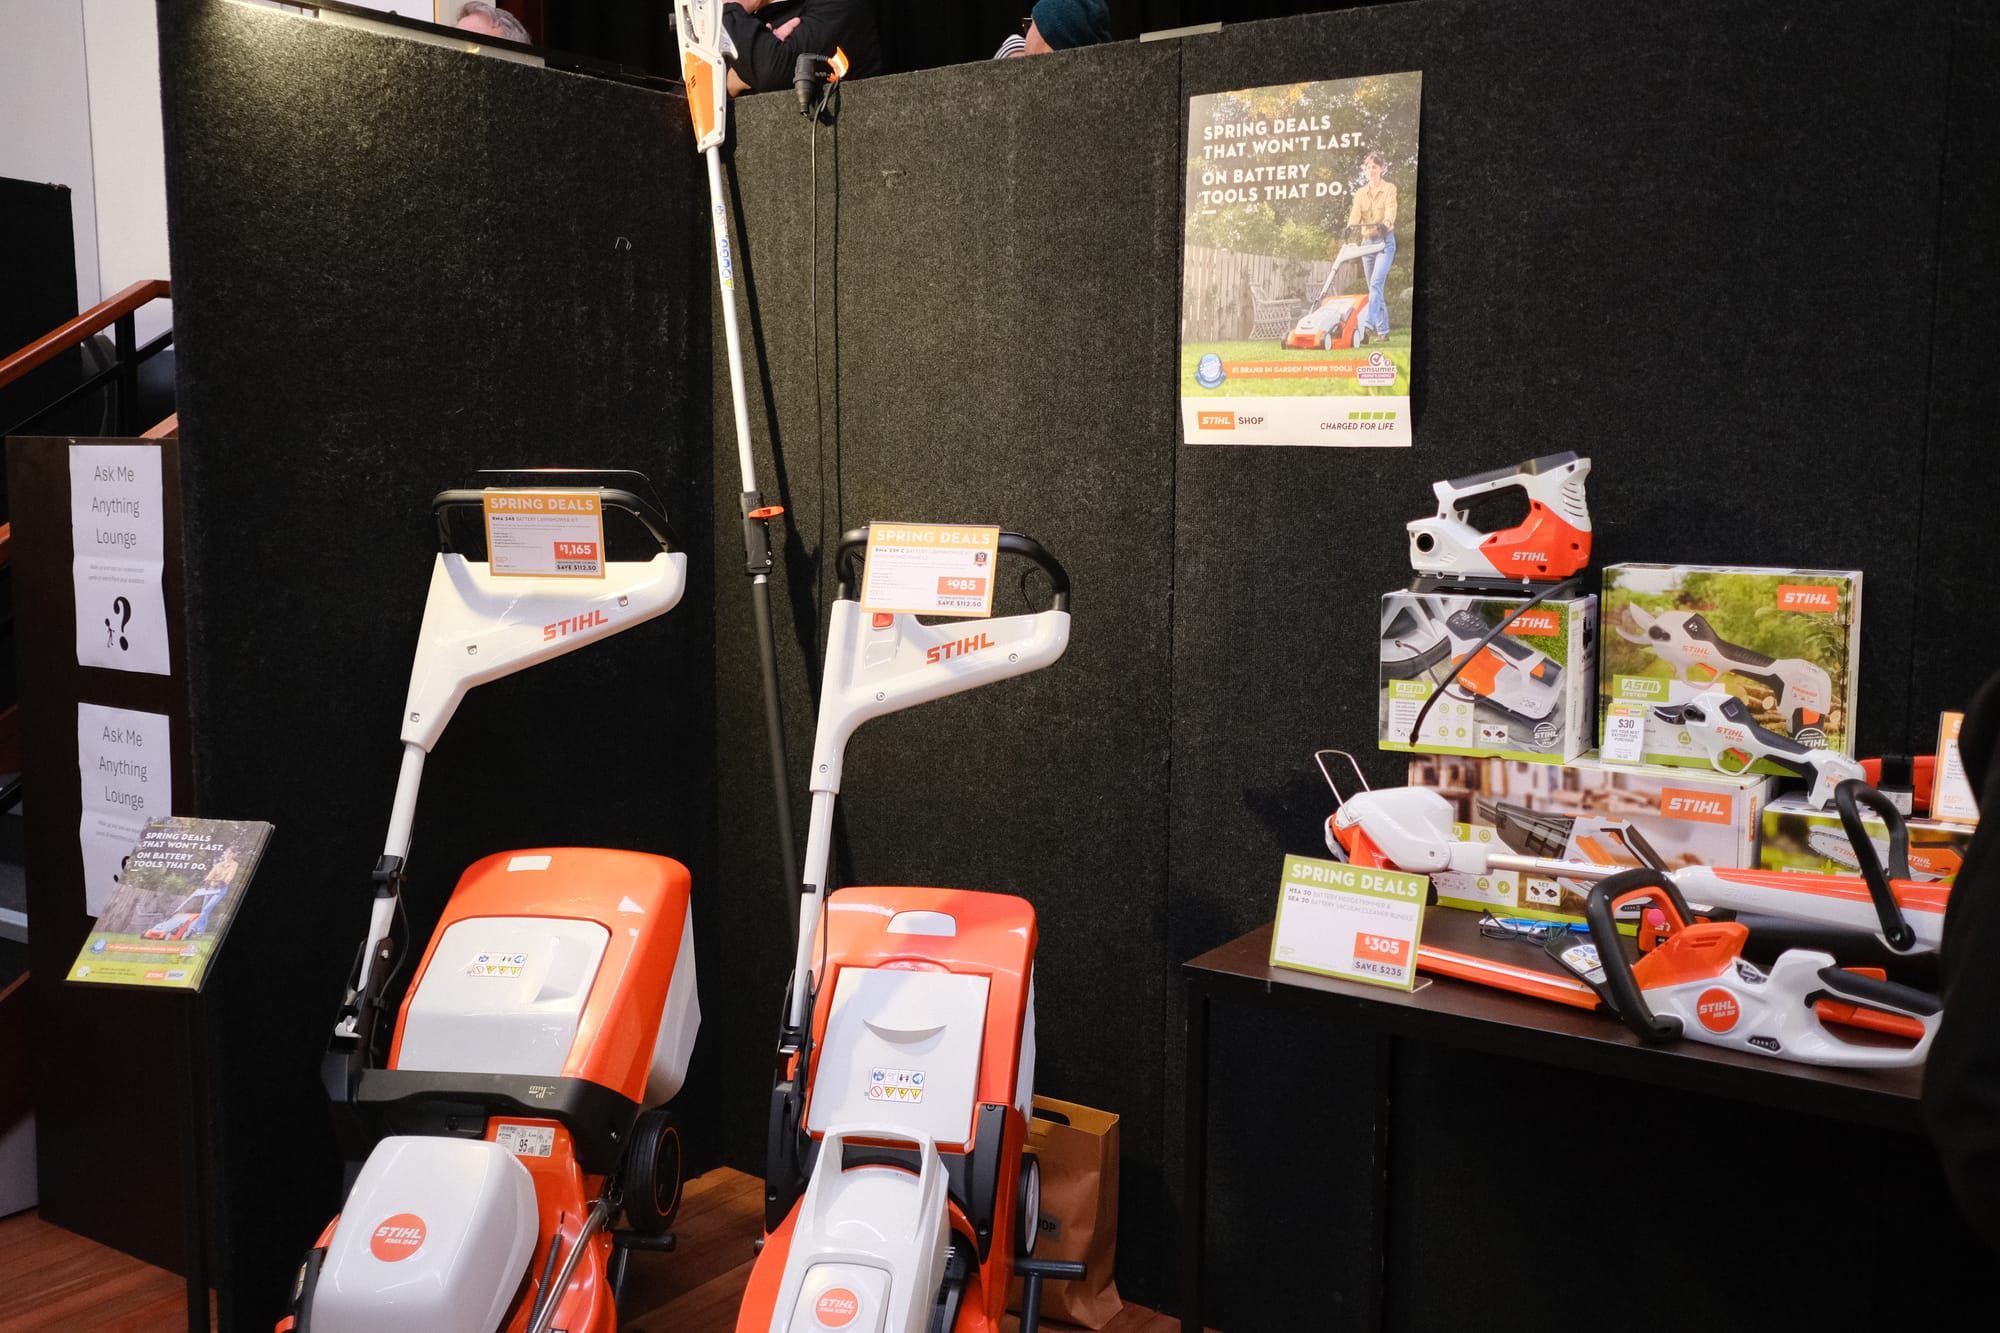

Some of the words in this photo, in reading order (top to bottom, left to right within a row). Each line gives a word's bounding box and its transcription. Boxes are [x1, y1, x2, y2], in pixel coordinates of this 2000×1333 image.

[1203, 121, 1267, 140] SPRING
[1273, 115, 1331, 134] DEALS
[1203, 142, 1246, 160] THAT
[1252, 136, 1310, 154] WON'T
[1316, 132, 1365, 150] LAST.
[1202, 170, 1227, 186] ON
[1233, 163, 1310, 184] BATTERY
[1201, 187, 1258, 204] TOOLS
[1264, 183, 1309, 200] THAT
[1315, 181, 1347, 197] DO.
[1273, 365, 1302, 373] GARDEN
[1329, 364, 1352, 372] TOOLS
[1202, 416, 1231, 424] STIHL
[1238, 416, 1264, 425] SHOP
[1320, 422, 1358, 431] CHARGED
[1360, 422, 1376, 430] FOR
[1377, 422, 1394, 430] LIFE
[94, 465, 115, 482] Ask
[117, 466, 134, 482] Me
[91, 496, 140, 518] Anything
[490, 497, 544, 510] SPRING
[548, 499, 594, 511] DEALS
[96, 528, 136, 549] Lounge
[877, 530, 935, 543] SPRING
[940, 531, 990, 545] DEALS
[560, 544, 591, 556] $1,165
[1512, 551, 1548, 562] STIHL
[946, 579, 976, 591] $985
[1784, 592, 1831, 606] STIHL
[544, 610, 608, 641] STIHL
[1510, 617, 1553, 629] STIHL
[926, 633, 995, 664] STIHL
[1682, 645, 1710, 655] STIHL
[1618, 719, 1634, 728] $30
[102, 725, 124, 743] Ask
[126, 729, 143, 747] Me
[1534, 731, 1558, 739] STIHL
[1715, 726, 1744, 738] STIHL
[99, 756, 148, 782] Anything
[105, 785, 144, 811] Lounge
[1669, 797, 1724, 815] STIHL
[145, 832, 180, 840] SPRING
[181, 833, 212, 842] DEALS
[168, 841, 198, 849] WON'T
[152, 852, 193, 861] BATTERY
[133, 860, 162, 868] TOOLS
[166, 861, 190, 869] THAT
[1291, 863, 1355, 887] SPRING
[1361, 875, 1418, 897] DEALS
[1364, 936, 1400, 954] $305
[1355, 961, 1377, 973] SAVE
[1379, 965, 1402, 977] $235
[1699, 1000, 1736, 1014] STIHL
[519, 1139, 528, 1152] 95
[376, 1226, 421, 1239] STIHL
[819, 1298, 856, 1309] STIHL
